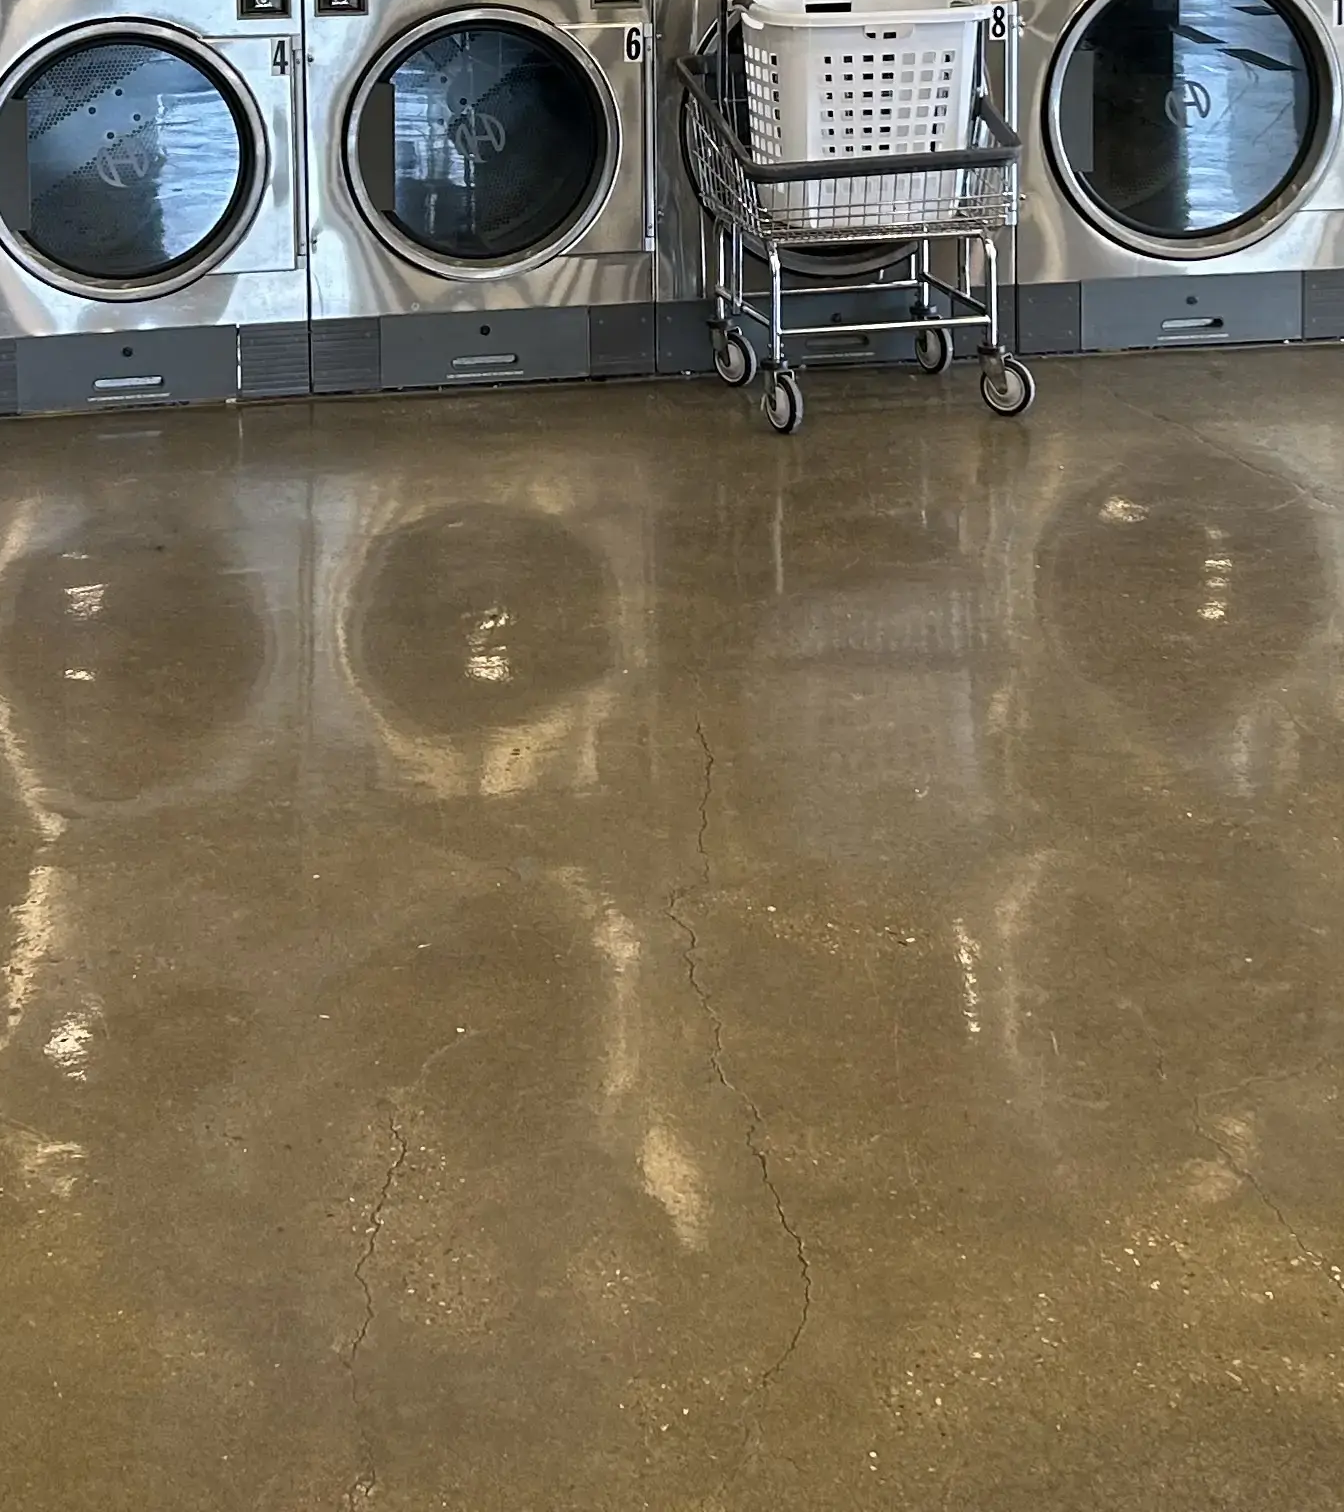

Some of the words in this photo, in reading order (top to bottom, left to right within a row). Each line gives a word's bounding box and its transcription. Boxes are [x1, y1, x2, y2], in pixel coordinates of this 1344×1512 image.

[992, 5, 1006, 38] 8
[273, 40, 289, 75] 4
[626, 27, 641, 61] 6
